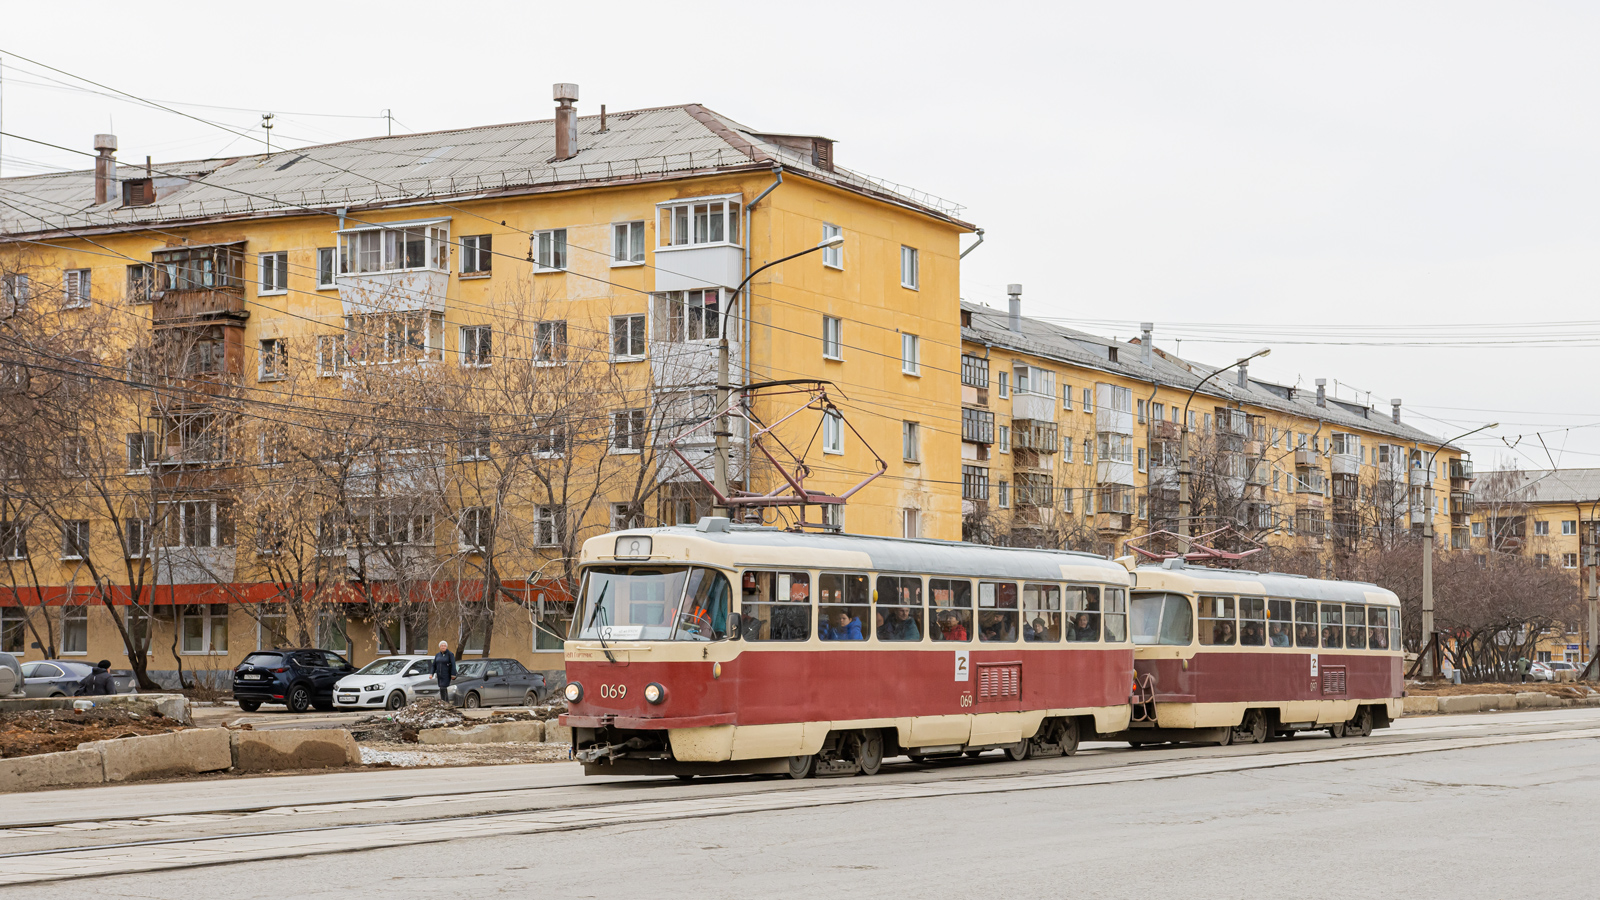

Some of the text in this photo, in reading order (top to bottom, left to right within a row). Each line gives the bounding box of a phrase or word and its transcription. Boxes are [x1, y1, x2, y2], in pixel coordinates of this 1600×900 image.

[629, 541, 640, 559] 8
[600, 684, 628, 699] 069
[960, 695, 972, 707] 069
